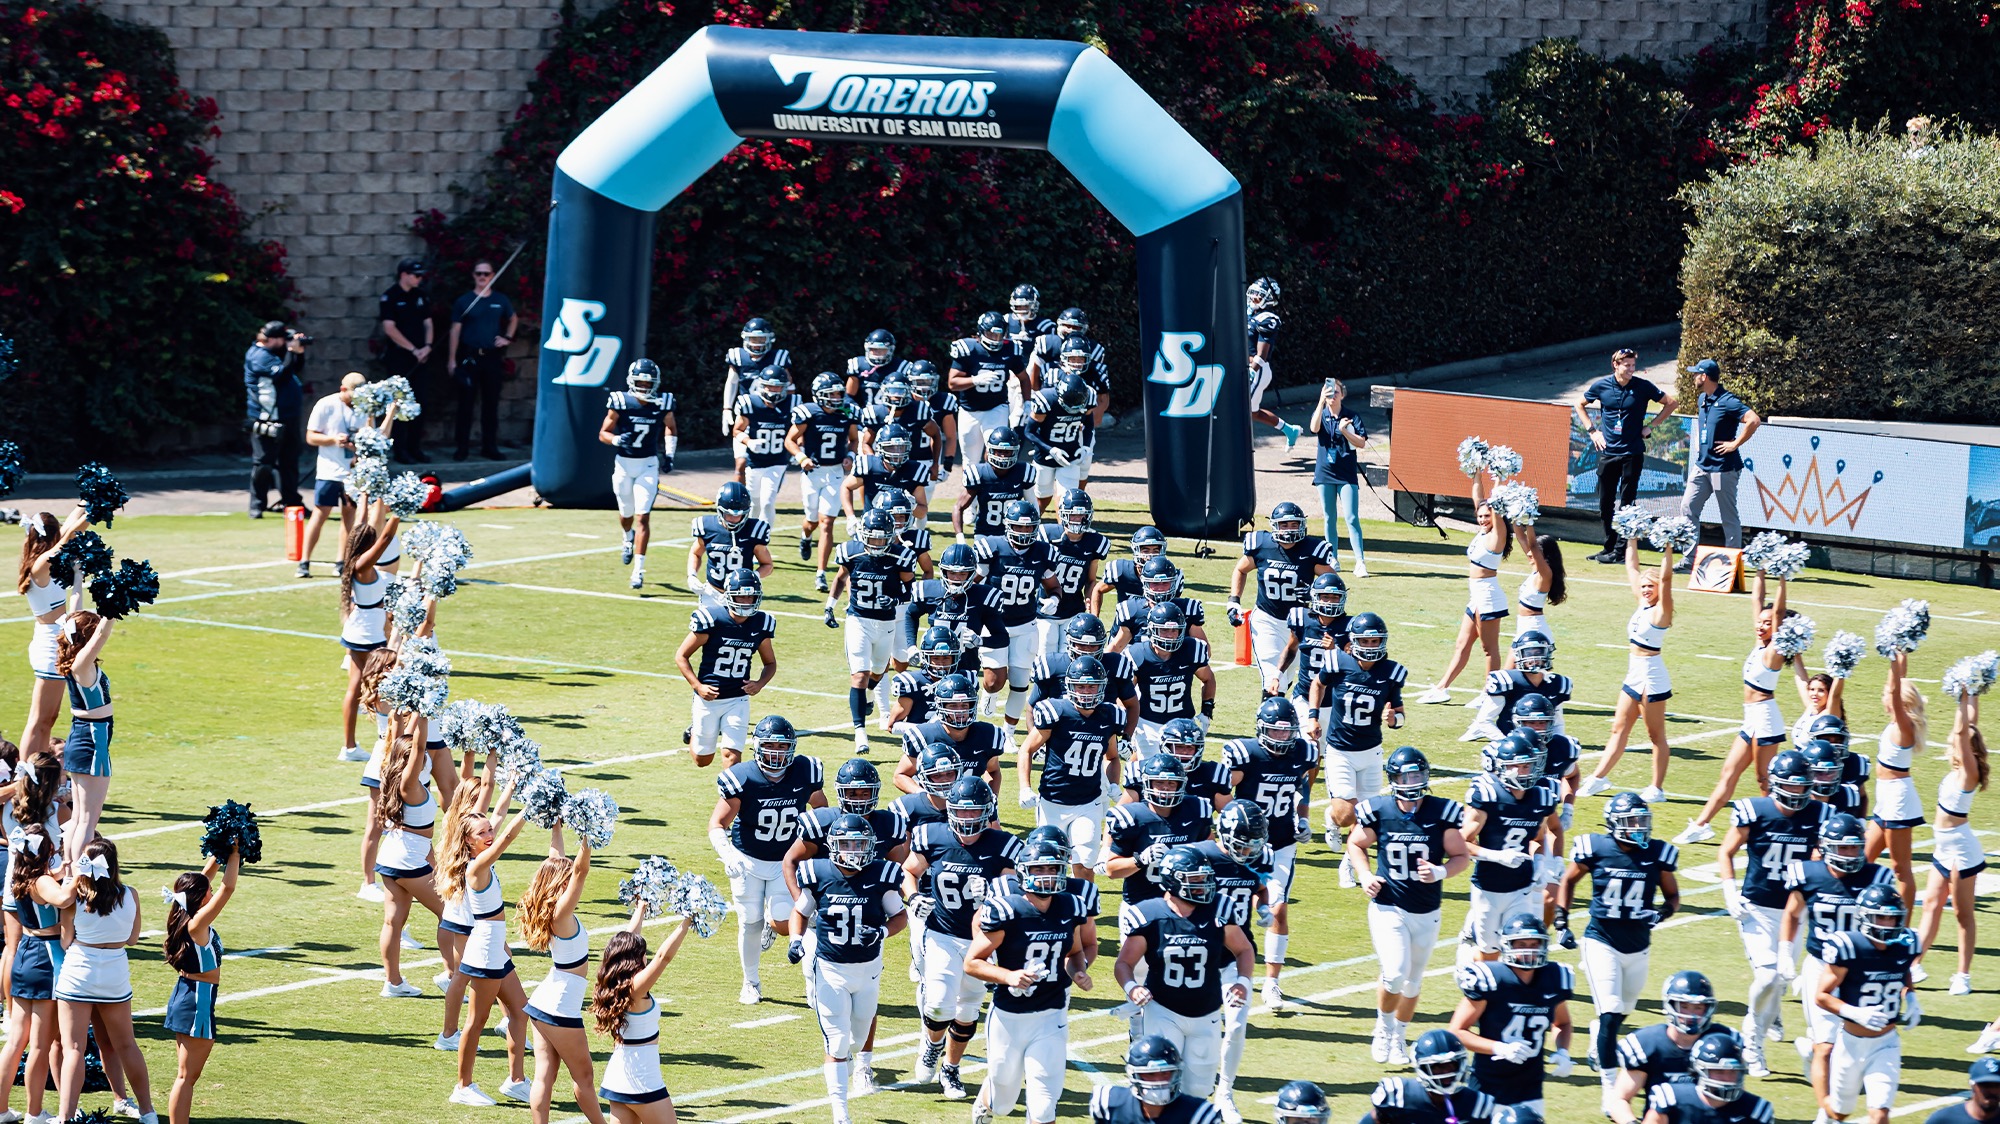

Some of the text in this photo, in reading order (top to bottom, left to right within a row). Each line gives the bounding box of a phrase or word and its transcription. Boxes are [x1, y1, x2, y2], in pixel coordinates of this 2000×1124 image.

[769, 53, 998, 118] TOREROS
[773, 113, 1002, 139] UNIVERSITY OF SAN DIEGO
[632, 424, 650, 448] 7
[820, 432, 838, 459] 2
[1049, 421, 1082, 443] 20
[1001, 574, 1036, 606] 99
[1054, 563, 1084, 594] 49
[1263, 568, 1298, 600] 62
[857, 580, 888, 610] 21
[713, 646, 753, 679] 26
[1149, 682, 1187, 714] 52
[1342, 691, 1376, 727] 12
[1068, 731, 1105, 742] TOREROS
[1064, 741, 1104, 777] 40
[758, 798, 798, 808] TOREROS
[1255, 782, 1296, 818] 56
[755, 807, 799, 842] 96
[1501, 816, 1540, 828] TOREROS
[1149, 834, 1189, 844] TOREROS
[941, 860, 984, 874] TOREROS
[1385, 842, 1430, 881] 93
[1215, 877, 1256, 887] TOREROS
[826, 893, 869, 904] TOREROS
[1601, 878, 1646, 919] 44
[827, 904, 863, 945] 31
[1025, 931, 1068, 942] TOREROS
[1164, 933, 1208, 945] TOREROS
[1163, 945, 1209, 989] 63
[1858, 981, 1905, 1019] 28
[1501, 1014, 1550, 1058] 43
